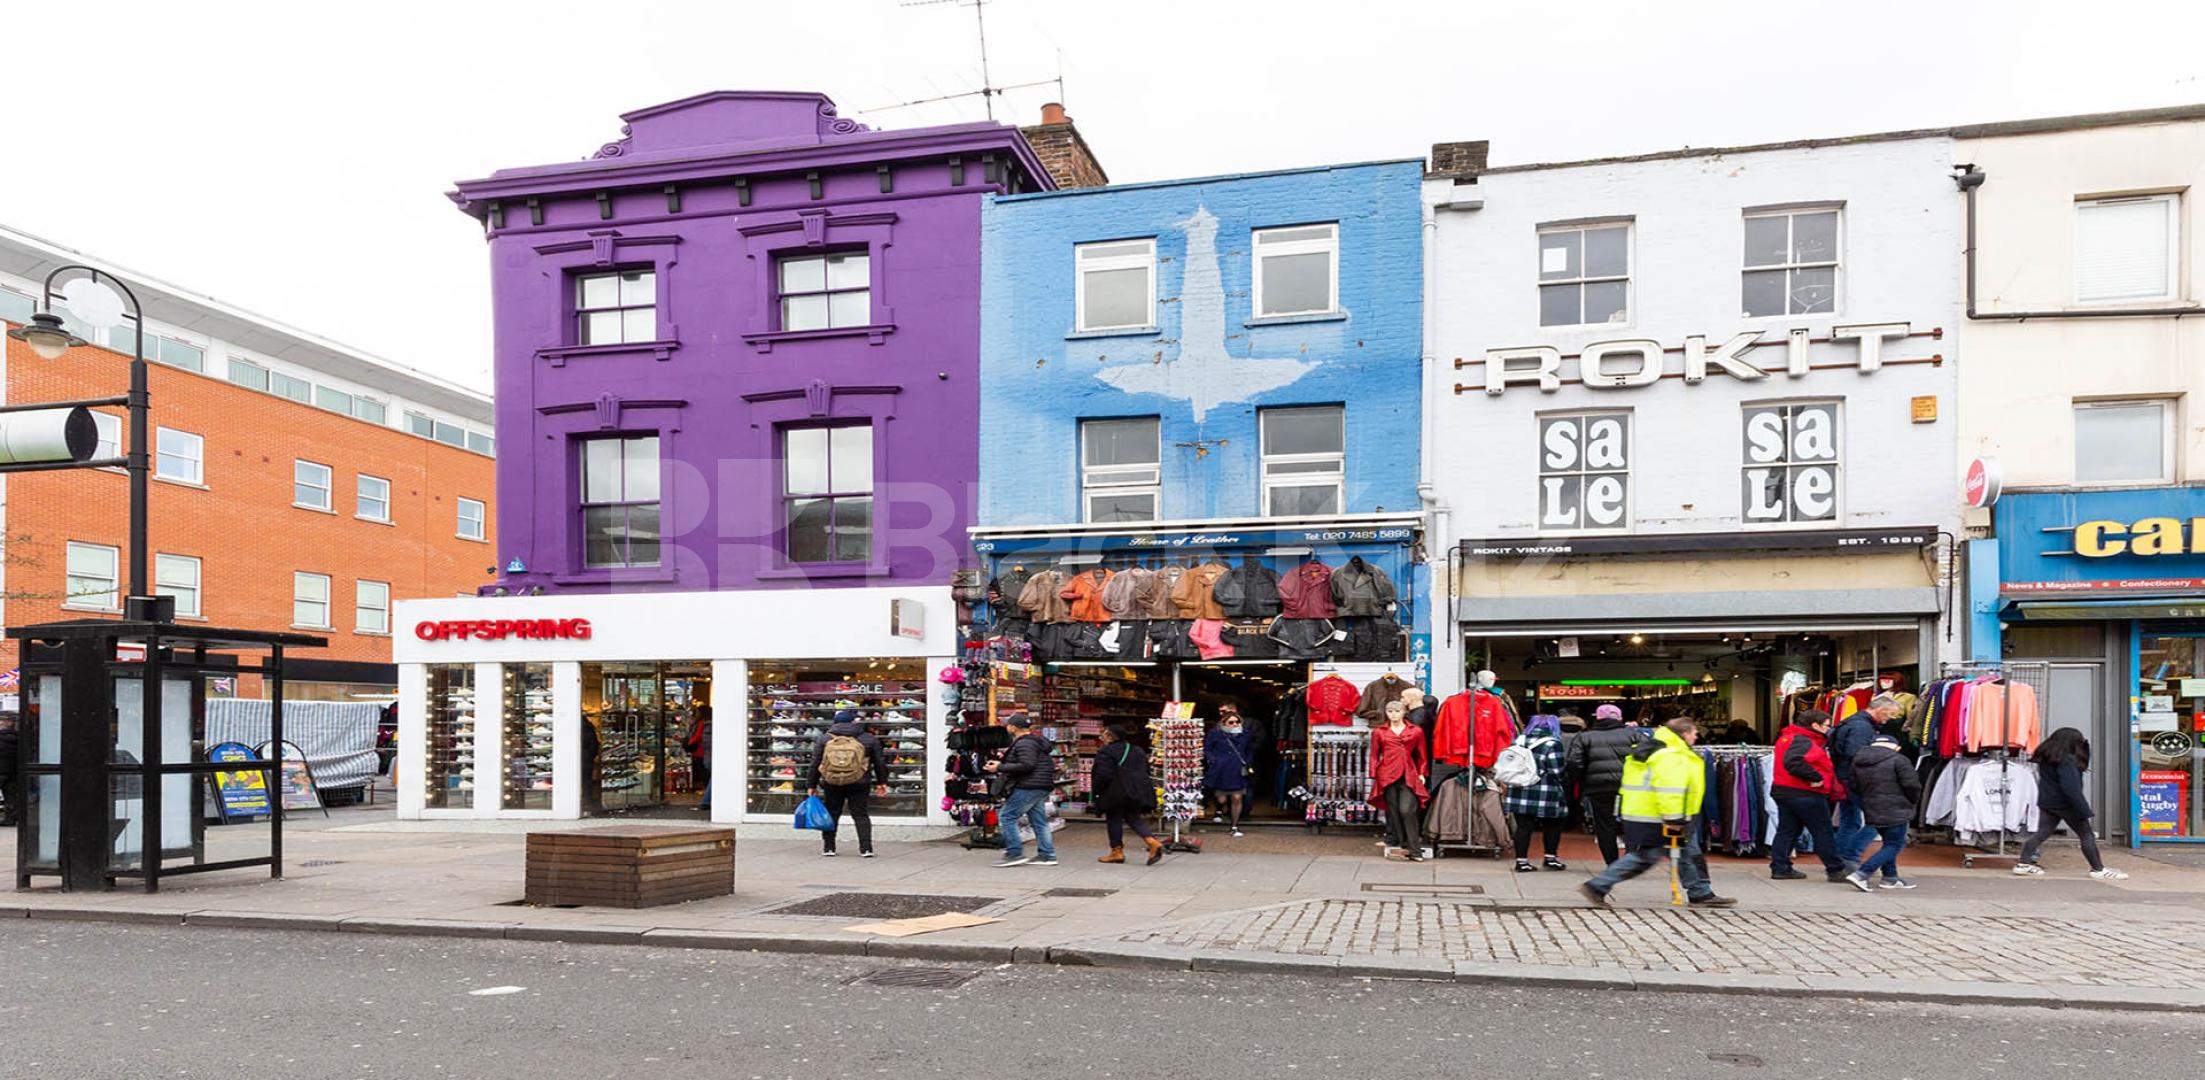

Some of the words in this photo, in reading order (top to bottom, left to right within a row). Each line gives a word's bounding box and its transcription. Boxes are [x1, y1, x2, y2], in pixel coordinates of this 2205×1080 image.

[1485, 321, 1911, 395] ROKIT
[1128, 536, 1169, 547] House
[1172, 536, 1190, 547] of
[1191, 533, 1240, 545] Leather
[1322, 531, 1346, 541] 020
[1379, 528, 1410, 539] 5899
[1838, 537, 1872, 546] EST.
[1473, 547, 1511, 555] ROKIT
[1516, 546, 1573, 554] VINTAGE
[2046, 581, 2092, 590] Magazine
[2120, 579, 2192, 588] Confectionery
[415, 617, 592, 642] OFFSPRING
[1549, 688, 1596, 696] ROOMS
